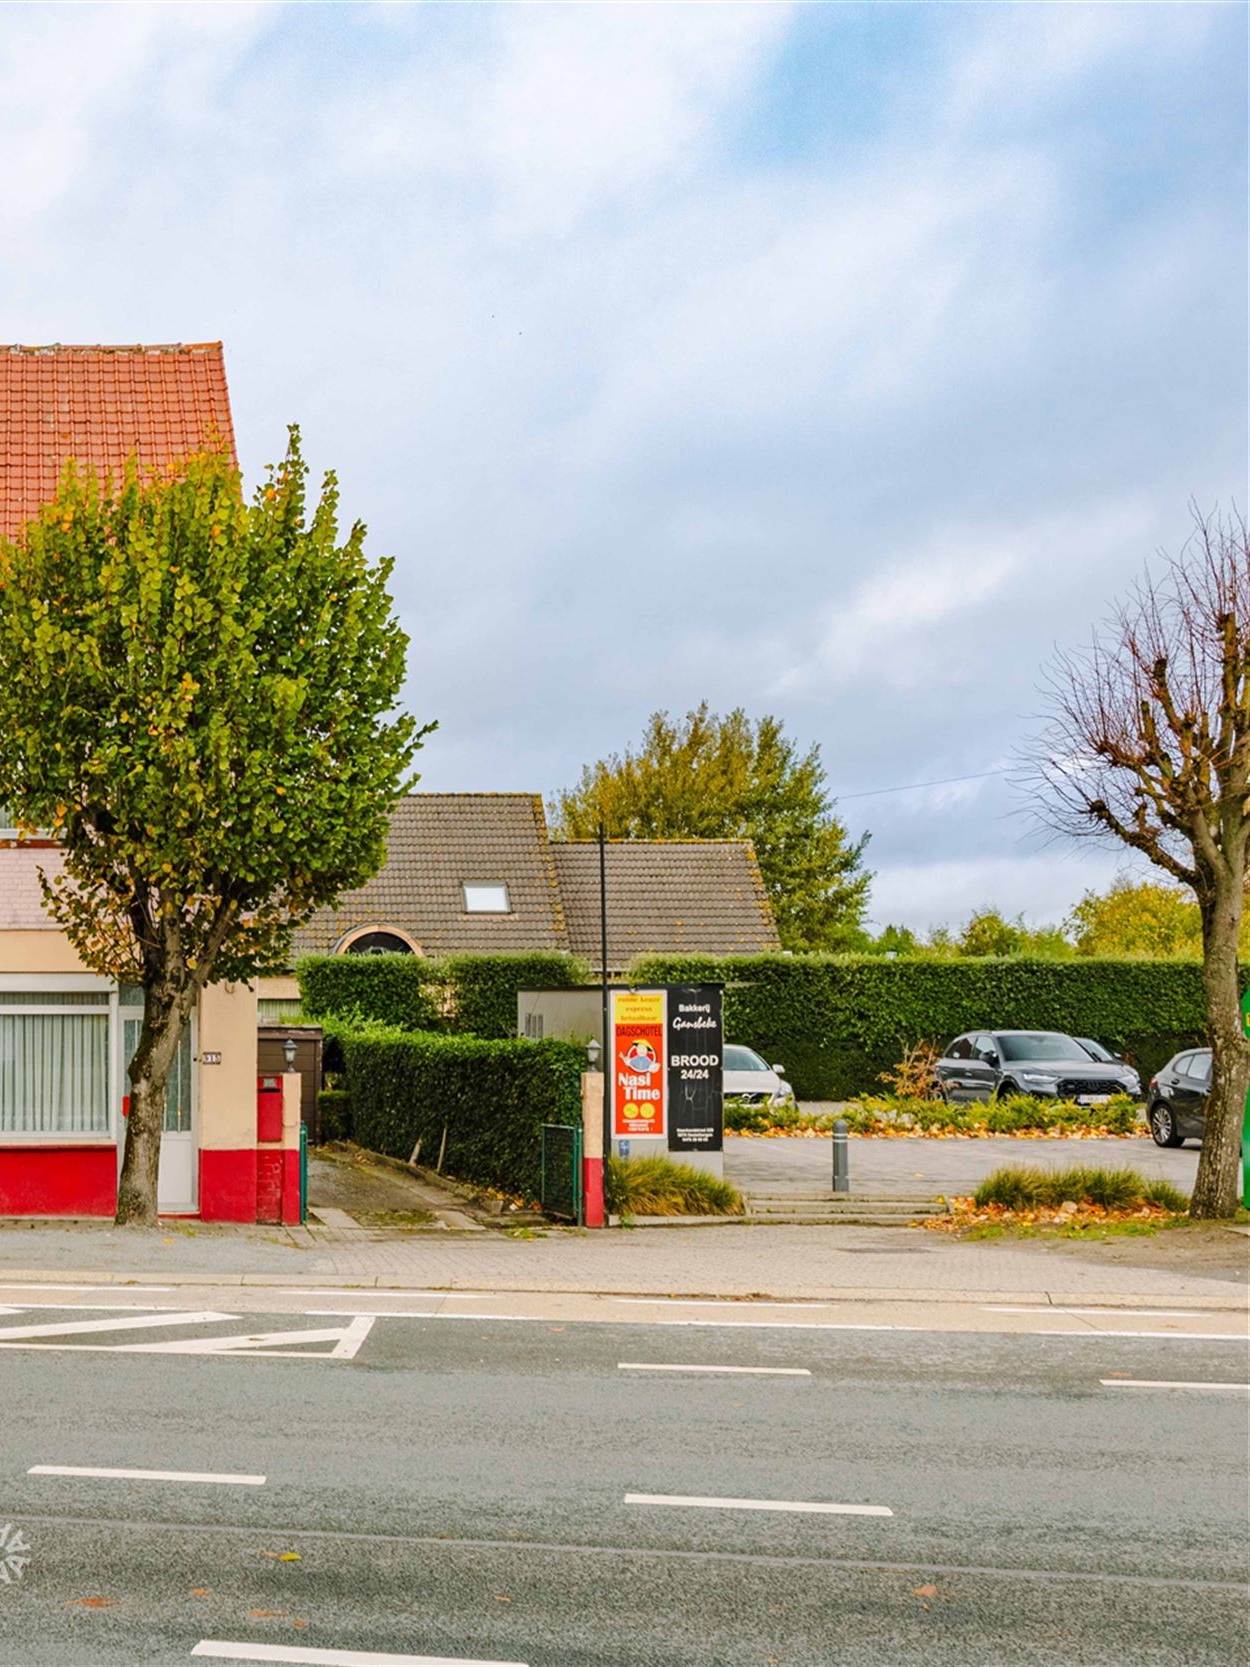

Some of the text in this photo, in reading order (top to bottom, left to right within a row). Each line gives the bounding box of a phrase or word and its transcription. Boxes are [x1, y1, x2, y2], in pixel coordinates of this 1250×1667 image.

[678, 1003, 711, 1014] Bakkerij
[616, 1026, 662, 1037] DAGSCHOTEL
[670, 1055, 719, 1067] BROOD
[618, 1072, 651, 1086] Nasi
[680, 1069, 710, 1080] 24/24
[623, 1086, 661, 1101] Time
